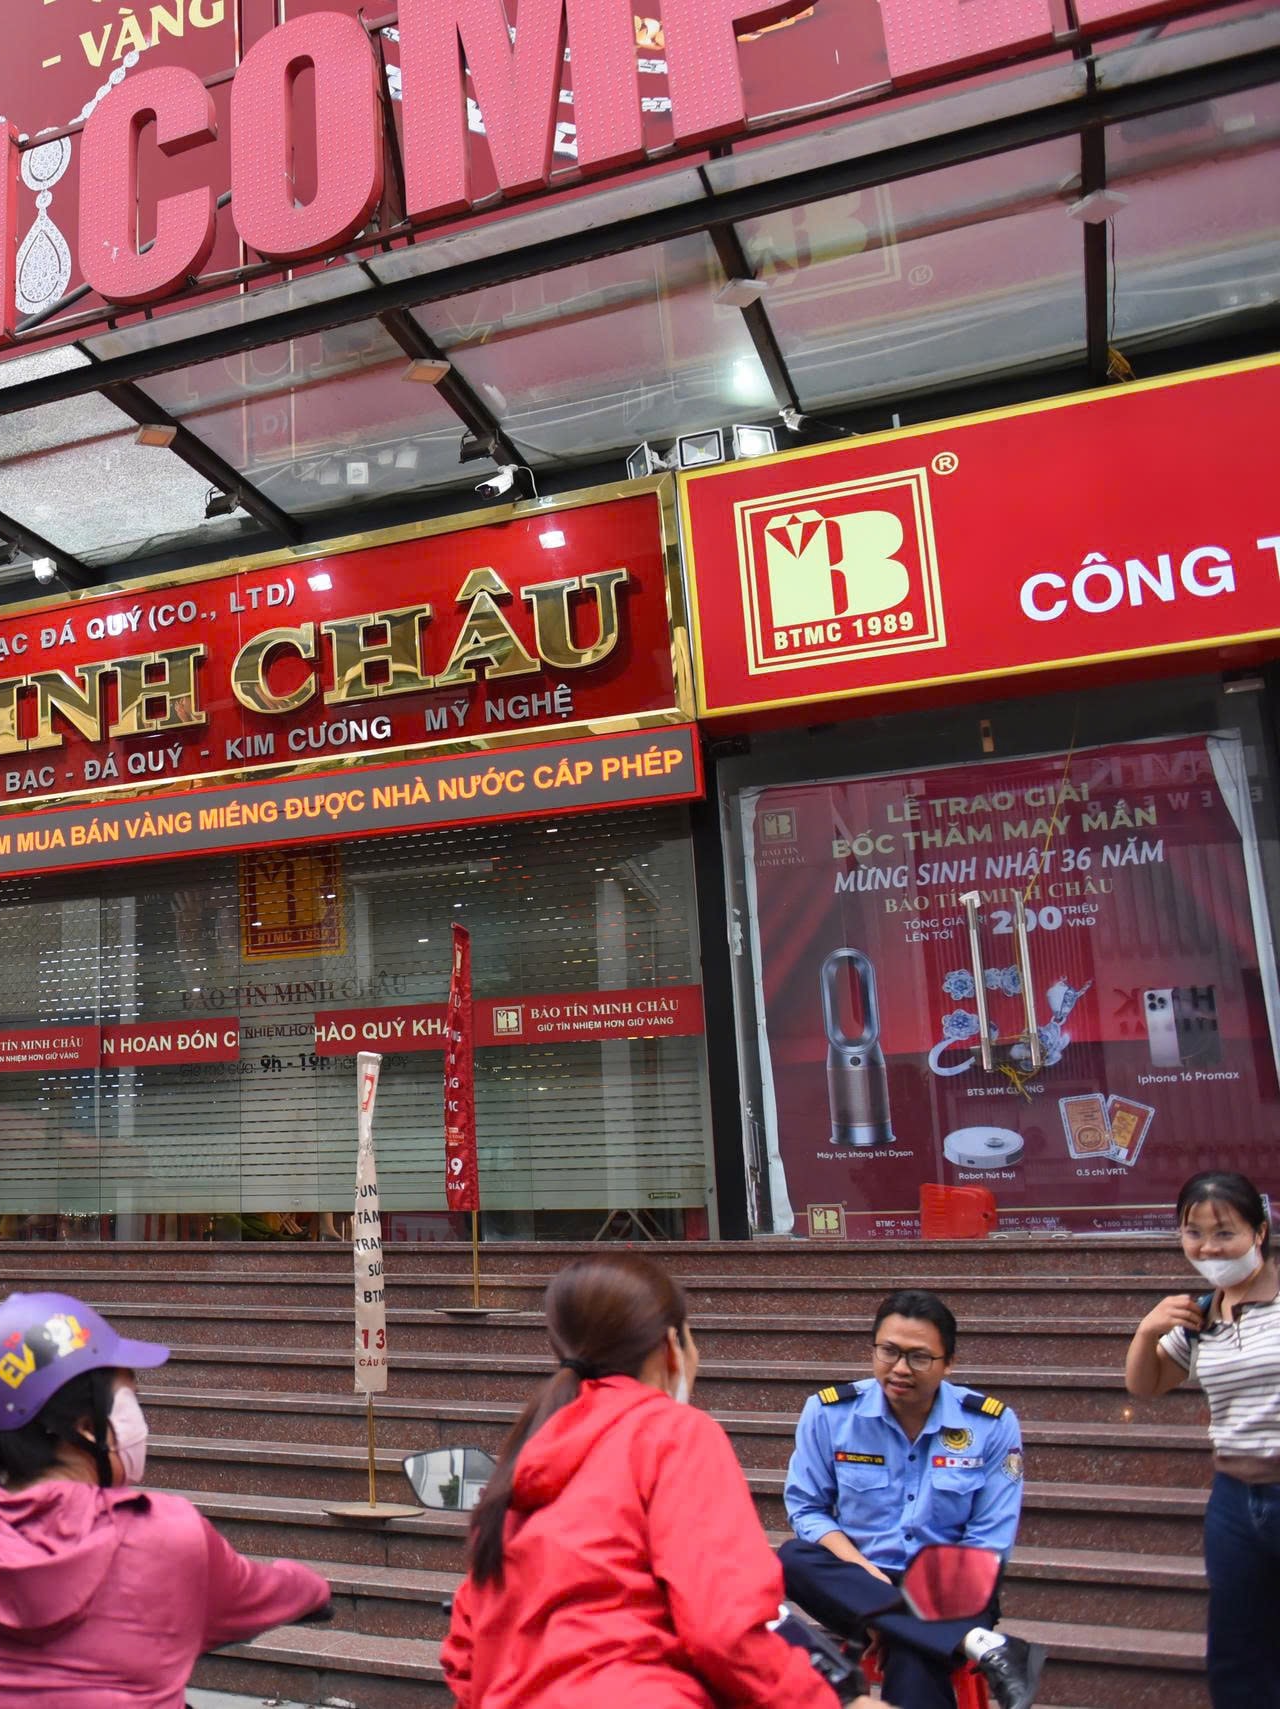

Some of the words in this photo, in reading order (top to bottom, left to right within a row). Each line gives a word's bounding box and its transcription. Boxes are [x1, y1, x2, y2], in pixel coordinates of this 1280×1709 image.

[79, 0, 226, 67] VÀNG
[1019, 546, 1237, 622] CÔNG
[40, 619, 76, 650] ĐÁ
[86, 604, 143, 641] QUÝ
[229, 578, 295, 613] LTD)
[231, 566, 629, 715] CHÂU
[774, 622, 842, 651] BTMC
[852, 611, 915, 638] 1989
[5, 766, 56, 795] BẠC
[84, 752, 119, 782] ĐÁ
[127, 742, 184, 776] QUÝ
[225, 733, 275, 761] KIM
[287, 715, 392, 752] CƯƠNG
[425, 699, 470, 732] MỸ
[485, 683, 574, 724] NGHỆ
[17, 828, 65, 853] MUA
[70, 815, 119, 847] BÁN
[124, 811, 194, 840] VÀNG
[199, 800, 278, 830] MIẾNG
[283, 790, 365, 821] ĐƯỢC
[372, 776, 431, 810] NHÀ
[438, 766, 525, 801] NƯỚC
[533, 757, 593, 790] CẤP
[602, 746, 684, 781] PHÉP
[886, 795, 920, 823] LỄ
[929, 791, 1015, 819] TRAO
[1024, 779, 1090, 808] GIẢI
[832, 829, 895, 858] BỐC
[902, 822, 993, 850] THĂM
[1003, 815, 1070, 841] MAY
[1082, 800, 1157, 833] MẮN
[834, 864, 908, 894] MỪNG
[917, 857, 976, 886] SINH
[985, 847, 1056, 881] NHẬT
[1061, 846, 1091, 872] 36
[1102, 837, 1164, 867] NĂM
[884, 894, 929, 914] BẢO
[1048, 875, 1114, 898] CHÂU
[1061, 903, 1099, 916] TRIỆU
[904, 916, 937, 930] TỔNG
[905, 930, 929, 943] LÊN
[932, 928, 954, 941] TỚI
[1067, 916, 1096, 928] VNĐ
[531, 1004, 560, 1019] BẢO
[563, 1003, 588, 1017] TÍN
[592, 1002, 632, 1016] MINH
[636, 998, 679, 1012] CHÂU
[362, 1017, 406, 1040] QUÝ
[604, 1018, 624, 1028] HƠN
[646, 1016, 674, 1026] VÀNG
[0, 1040, 18, 1051] TÍN
[20, 1038, 50, 1050] MINH
[52, 1036, 84, 1049] CHÂU
[120, 1036, 171, 1053] HOAN
[177, 1029, 218, 1050] ĐÓN
[1138, 1074, 1177, 1085] Iphone
[1182, 1073, 1192, 1083] 16
[1195, 1070, 1240, 1082] Promax
[967, 1087, 984, 1097] BTS
[987, 1086, 1005, 1096] KIM
[889, 1148, 913, 1159] Dyson
[958, 1171, 984, 1180] Robot
[986, 1170, 1000, 1180] hút
[1076, 1168, 1089, 1177] 0.5
[1106, 1167, 1128, 1176] VRTL
